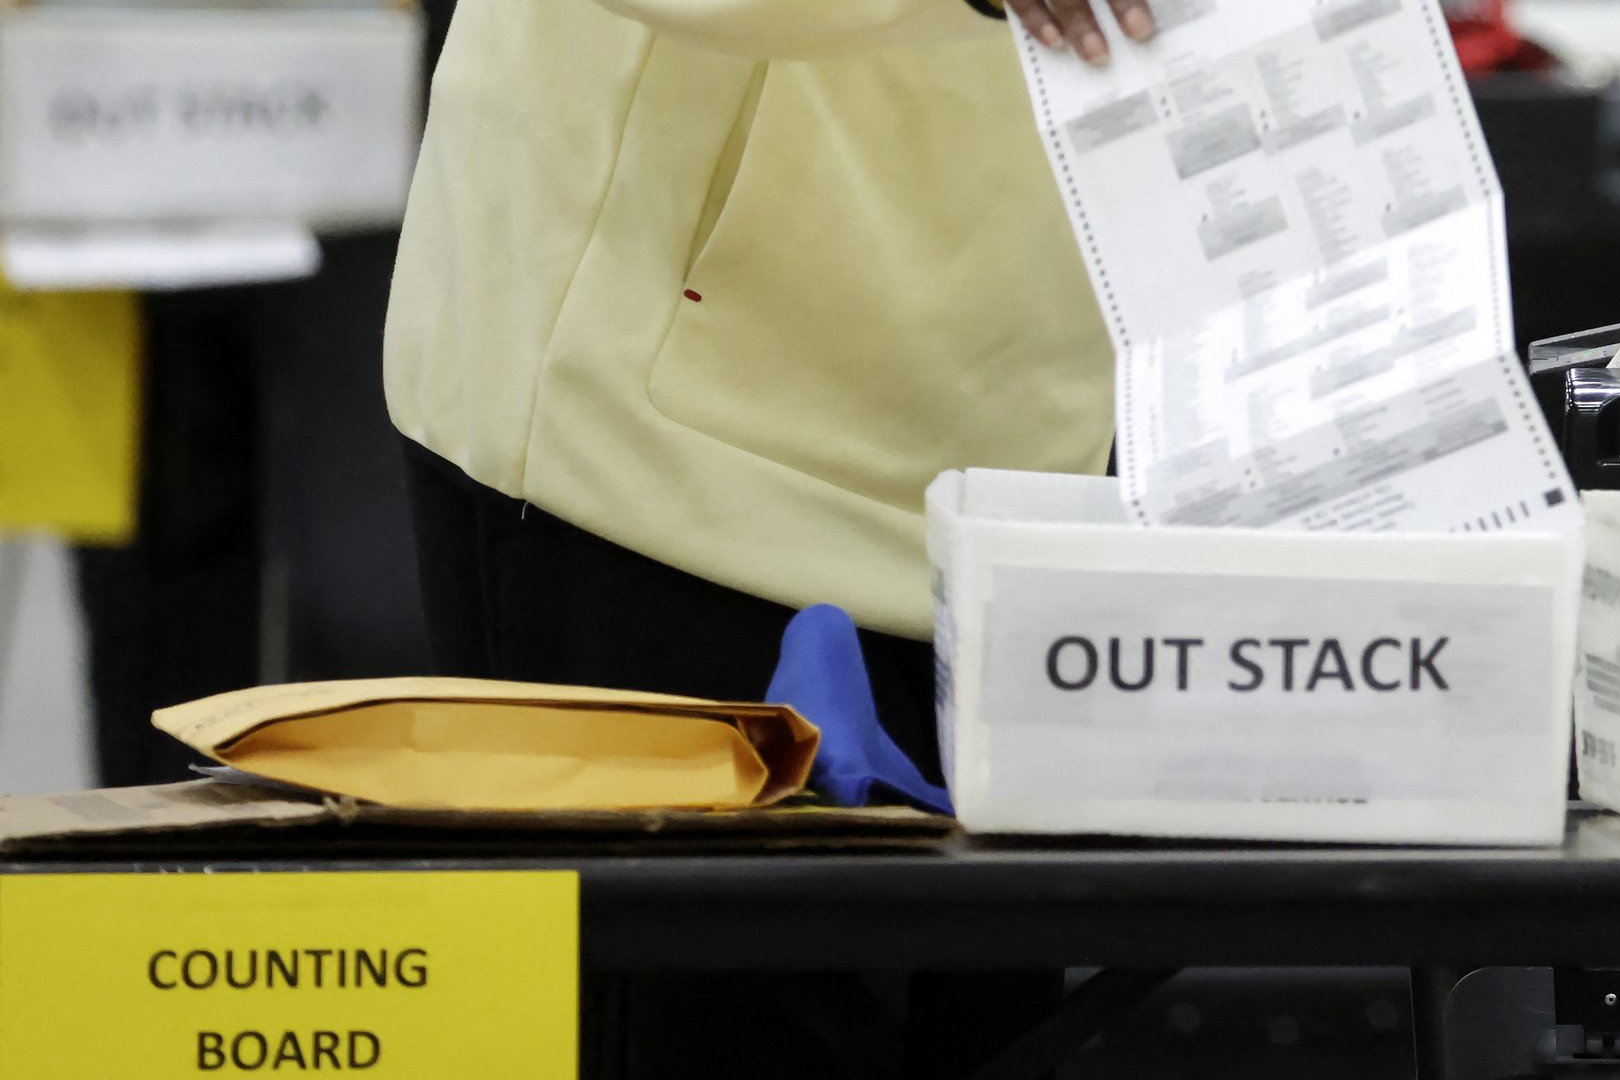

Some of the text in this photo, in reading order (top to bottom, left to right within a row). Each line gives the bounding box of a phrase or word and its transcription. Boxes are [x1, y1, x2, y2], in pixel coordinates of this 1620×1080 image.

[1045, 635, 1450, 692] OUT STACK
[147, 948, 429, 991] COUNTING
[196, 1029, 382, 1071] BOARD
